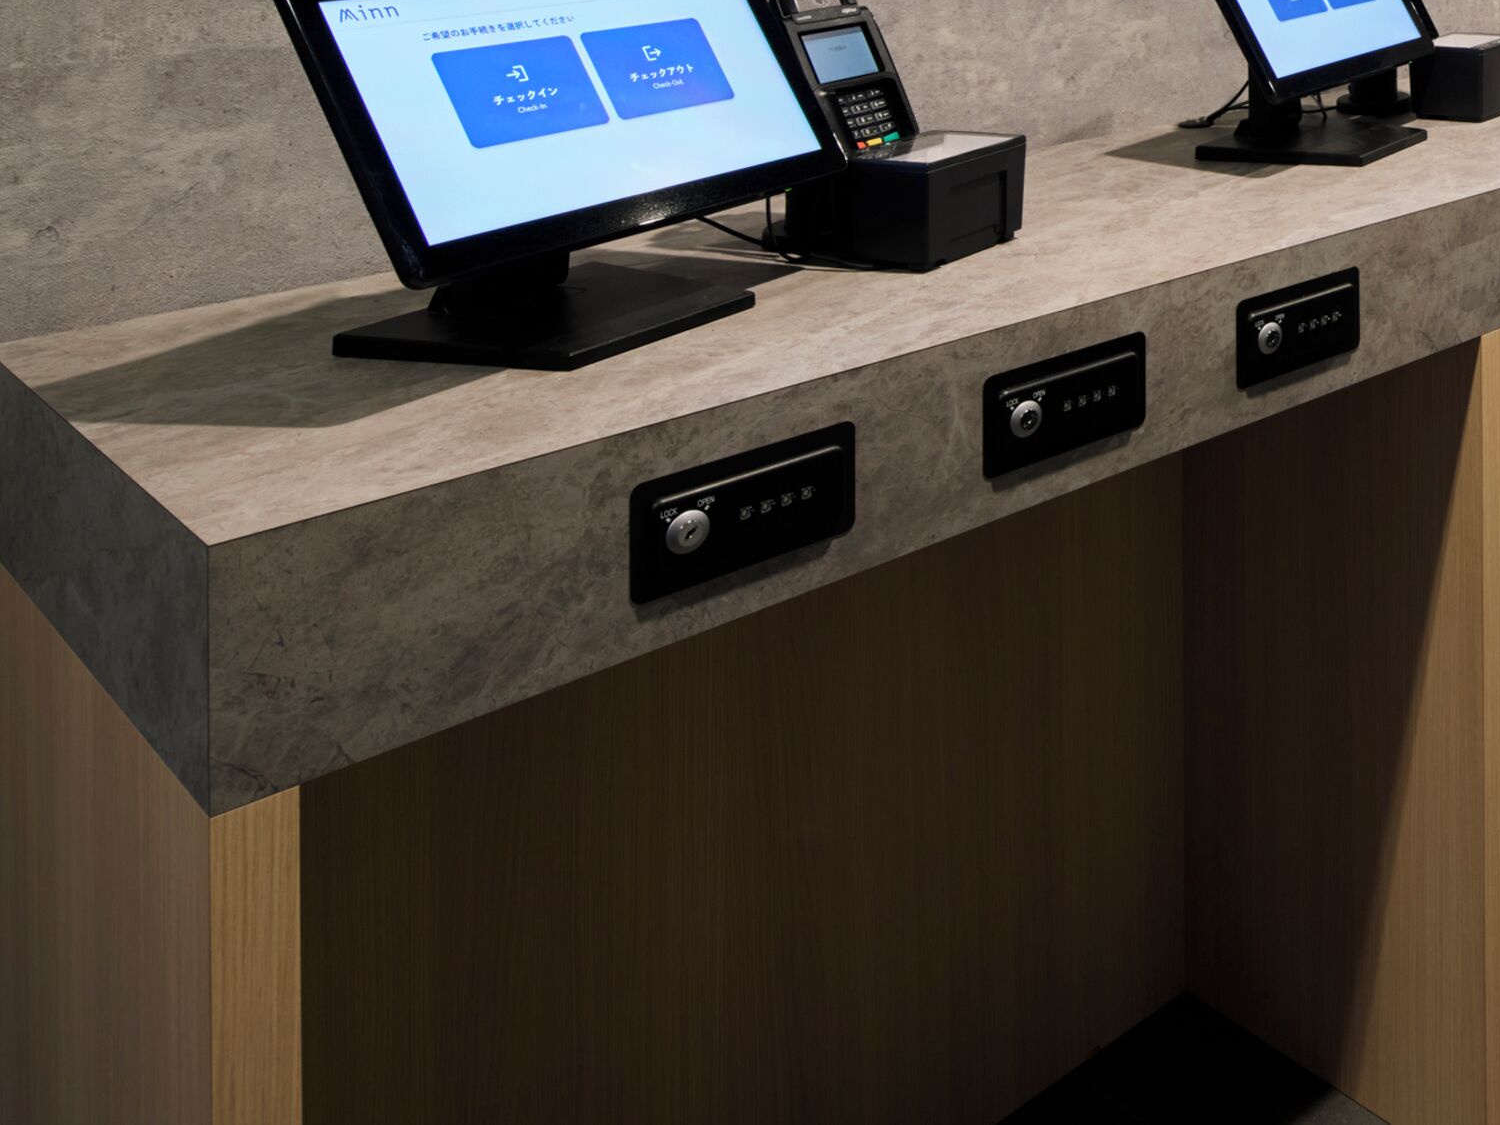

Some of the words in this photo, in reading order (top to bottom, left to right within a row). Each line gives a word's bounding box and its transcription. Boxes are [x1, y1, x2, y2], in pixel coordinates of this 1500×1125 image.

[339, 4, 400, 23] Minn
[422, 15, 575, 41] ご希望のお手続きを選択してください
[629, 62, 695, 83] チェックアウト
[492, 86, 559, 107] チェックイン
[660, 507, 679, 520] LOCK
[697, 495, 716, 508] OPEN
